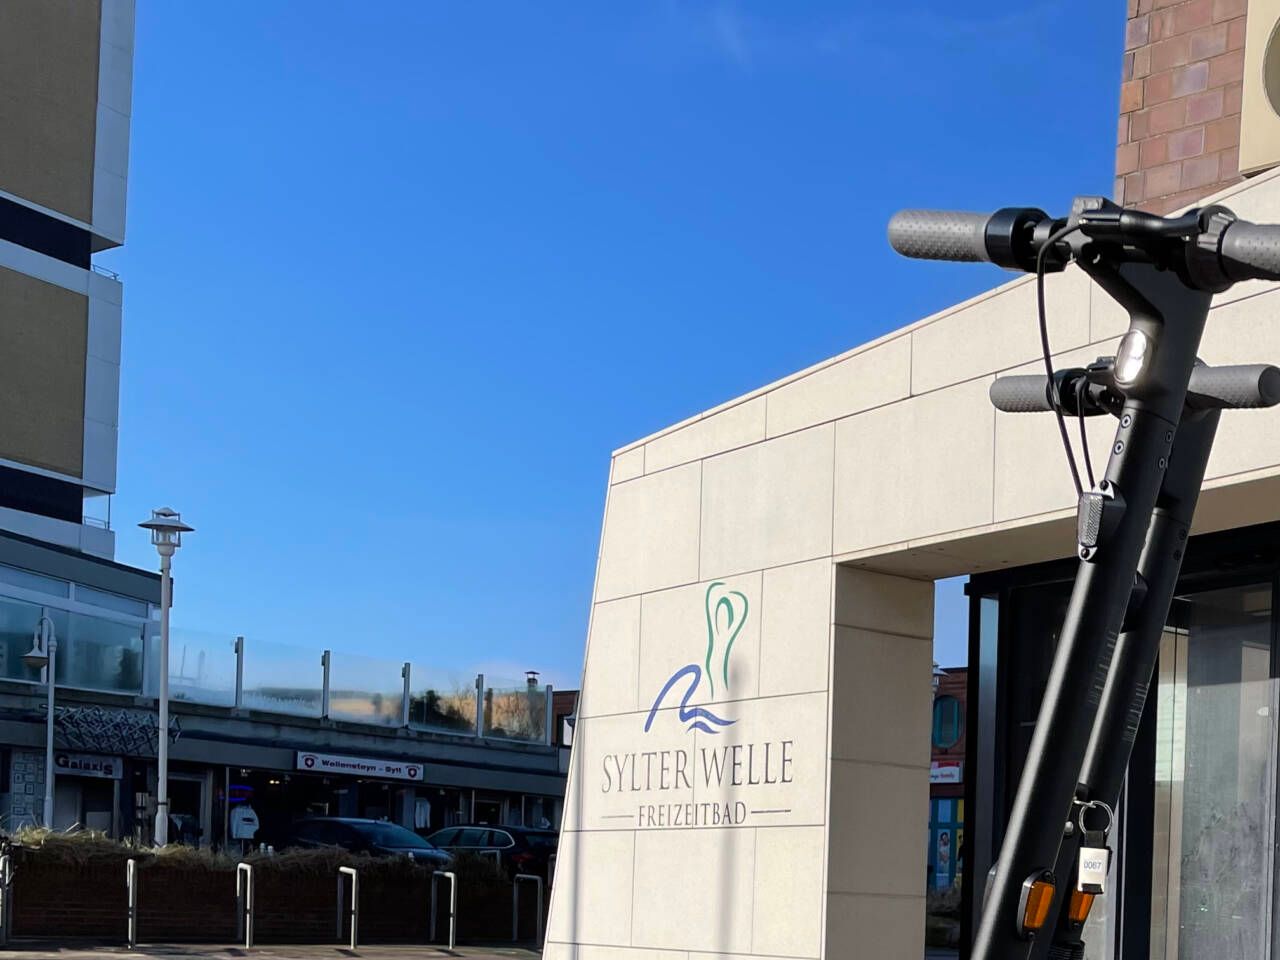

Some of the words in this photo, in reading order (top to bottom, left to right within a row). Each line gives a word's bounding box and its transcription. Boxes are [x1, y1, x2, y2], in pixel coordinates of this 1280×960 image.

[601, 749, 692, 793] SYLTER
[701, 740, 793, 789] WELLE
[638, 801, 747, 827] FREIZEITBAD
